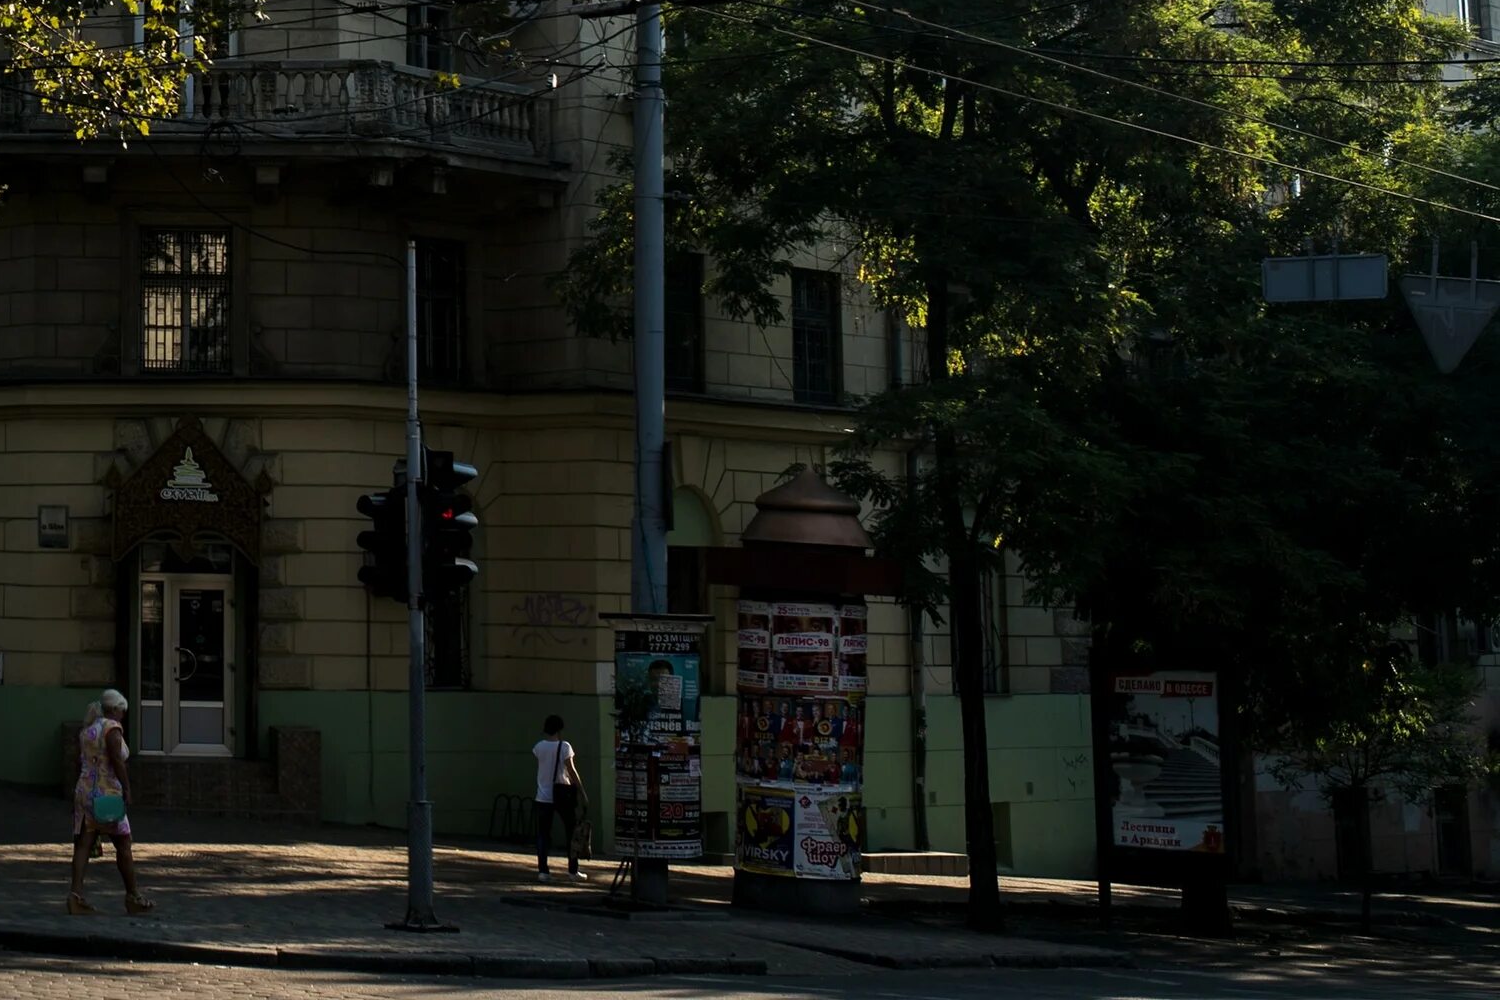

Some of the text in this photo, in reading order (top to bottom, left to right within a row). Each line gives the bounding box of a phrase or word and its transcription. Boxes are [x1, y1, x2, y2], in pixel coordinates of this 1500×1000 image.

[1118, 679, 1161, 691] СДЕЛАНО
[1120, 820, 1176, 834] Лестница
[1131, 834, 1181, 847] Аркадии
[743, 845, 790, 863] VIRSKY
[808, 852, 837, 867] шоу
